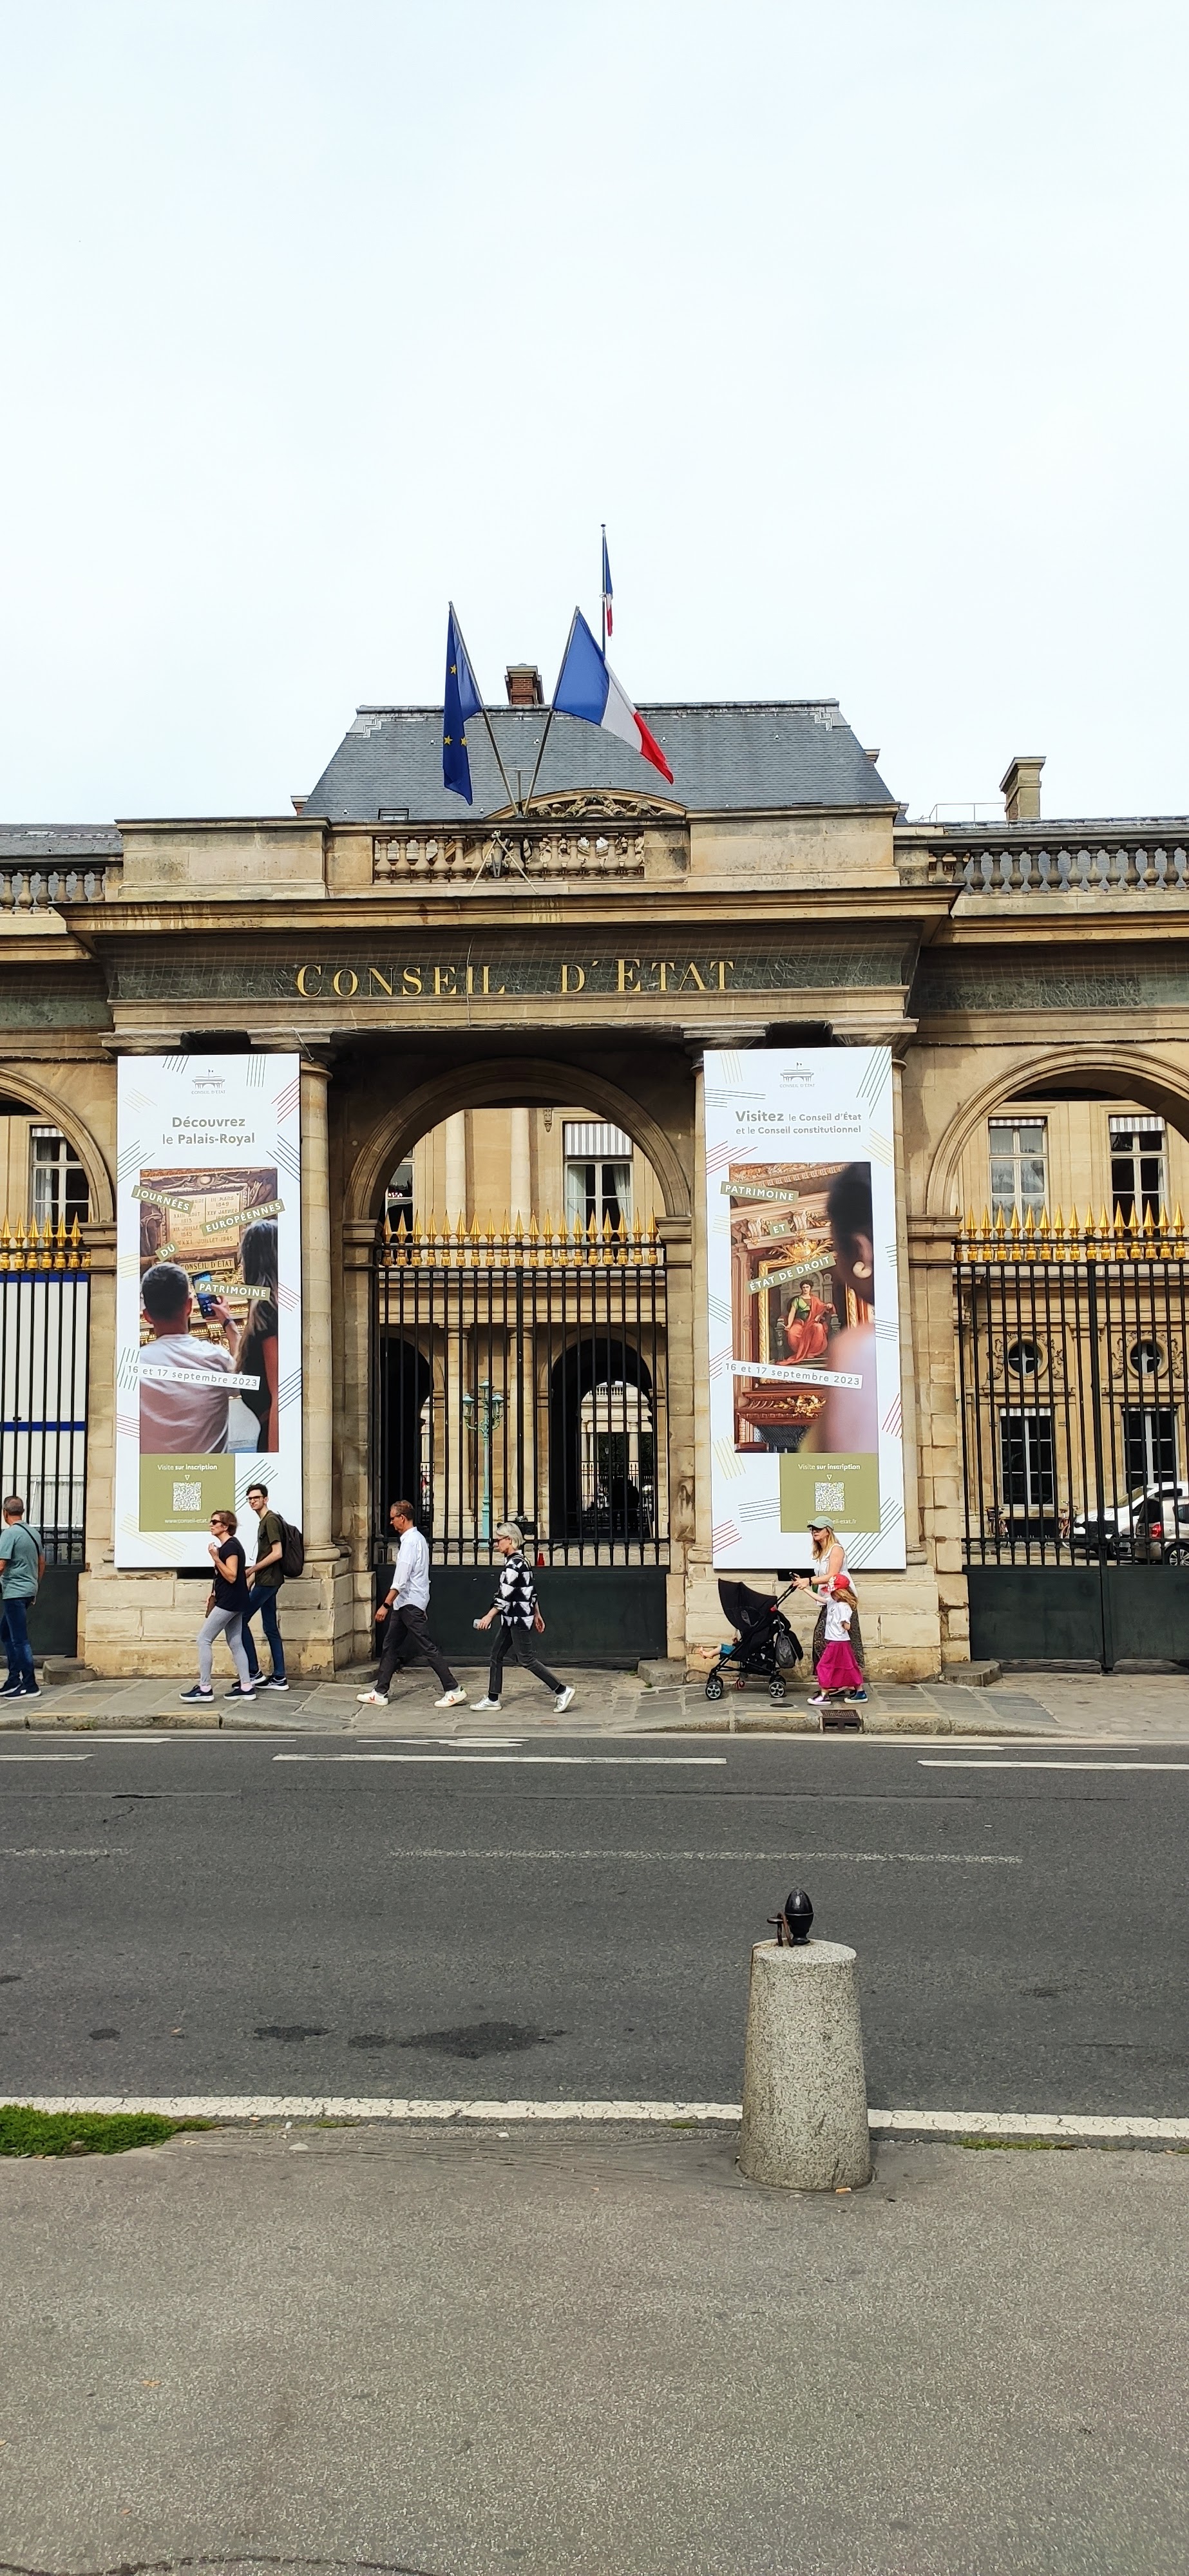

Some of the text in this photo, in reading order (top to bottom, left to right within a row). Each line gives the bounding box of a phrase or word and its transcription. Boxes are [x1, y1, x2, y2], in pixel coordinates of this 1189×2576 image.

[296, 964, 505, 997] CONSEIL
[172, 1116, 245, 1128] Découvrez
[736, 1110, 785, 1122] Visitez
[799, 1112, 832, 1121] Conseil
[834, 1112, 862, 1121] d'État
[758, 1125, 790, 1134] Conseil
[793, 1125, 861, 1133] constitutionnel
[162, 1133, 255, 1146] le Palais-Royal
[135, 1188, 190, 1211] JOURNÉES
[725, 1184, 794, 1202] PATRIMOINE
[205, 1202, 281, 1233] EUROPÉENNES
[773, 1224, 785, 1234] ET
[160, 1244, 175, 1258] DU
[749, 1255, 830, 1292] ÉTAT DE DROIT
[199, 1283, 267, 1298] PATRIMOINE
[128, 1365, 138, 1374] 16
[157, 1368, 168, 1377] 17
[172, 1371, 228, 1384] septembre
[233, 1377, 257, 1387] 2023
[725, 1363, 736, 1371] 16
[771, 1369, 830, 1382] septembre
[833, 1376, 859, 1385] 2023
